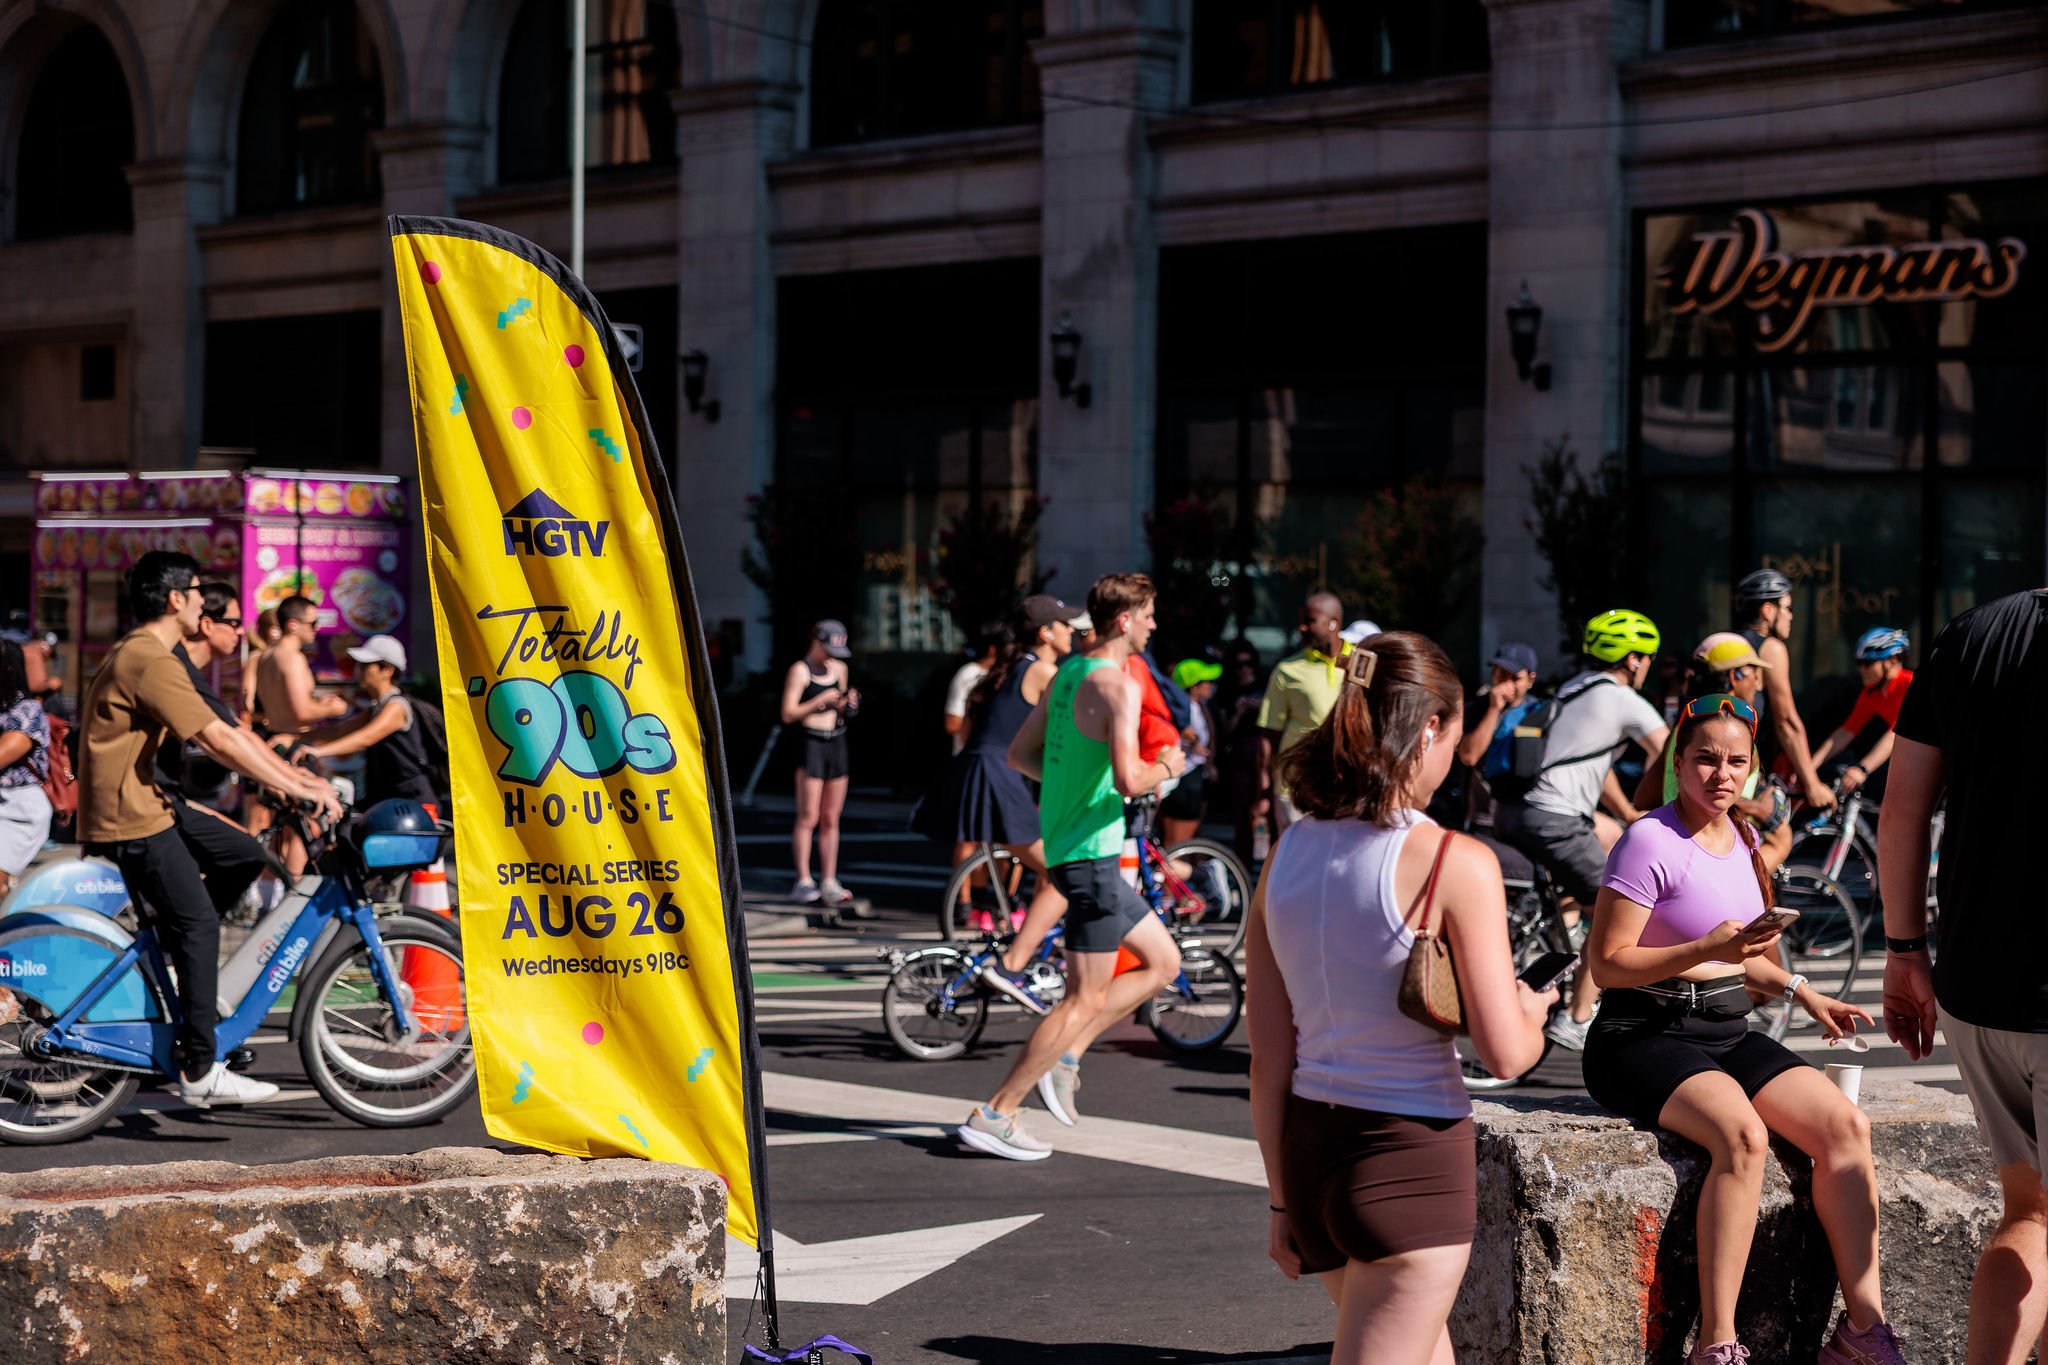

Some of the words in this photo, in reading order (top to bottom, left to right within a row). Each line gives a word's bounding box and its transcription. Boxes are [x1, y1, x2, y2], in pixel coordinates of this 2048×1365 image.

[1654, 207, 2027, 353] Wegmans
[501, 518, 610, 557] HGTV
[477, 604, 643, 689] Totally
[497, 862, 599, 886] SPECIAL
[602, 859, 681, 884] SERIES
[501, 895, 617, 940] AUG
[627, 891, 686, 937] 26
[12, 959, 48, 977] bike
[278, 936, 309, 972] bike
[502, 954, 644, 979] Wednesdays
[267, 965, 291, 993] citi
